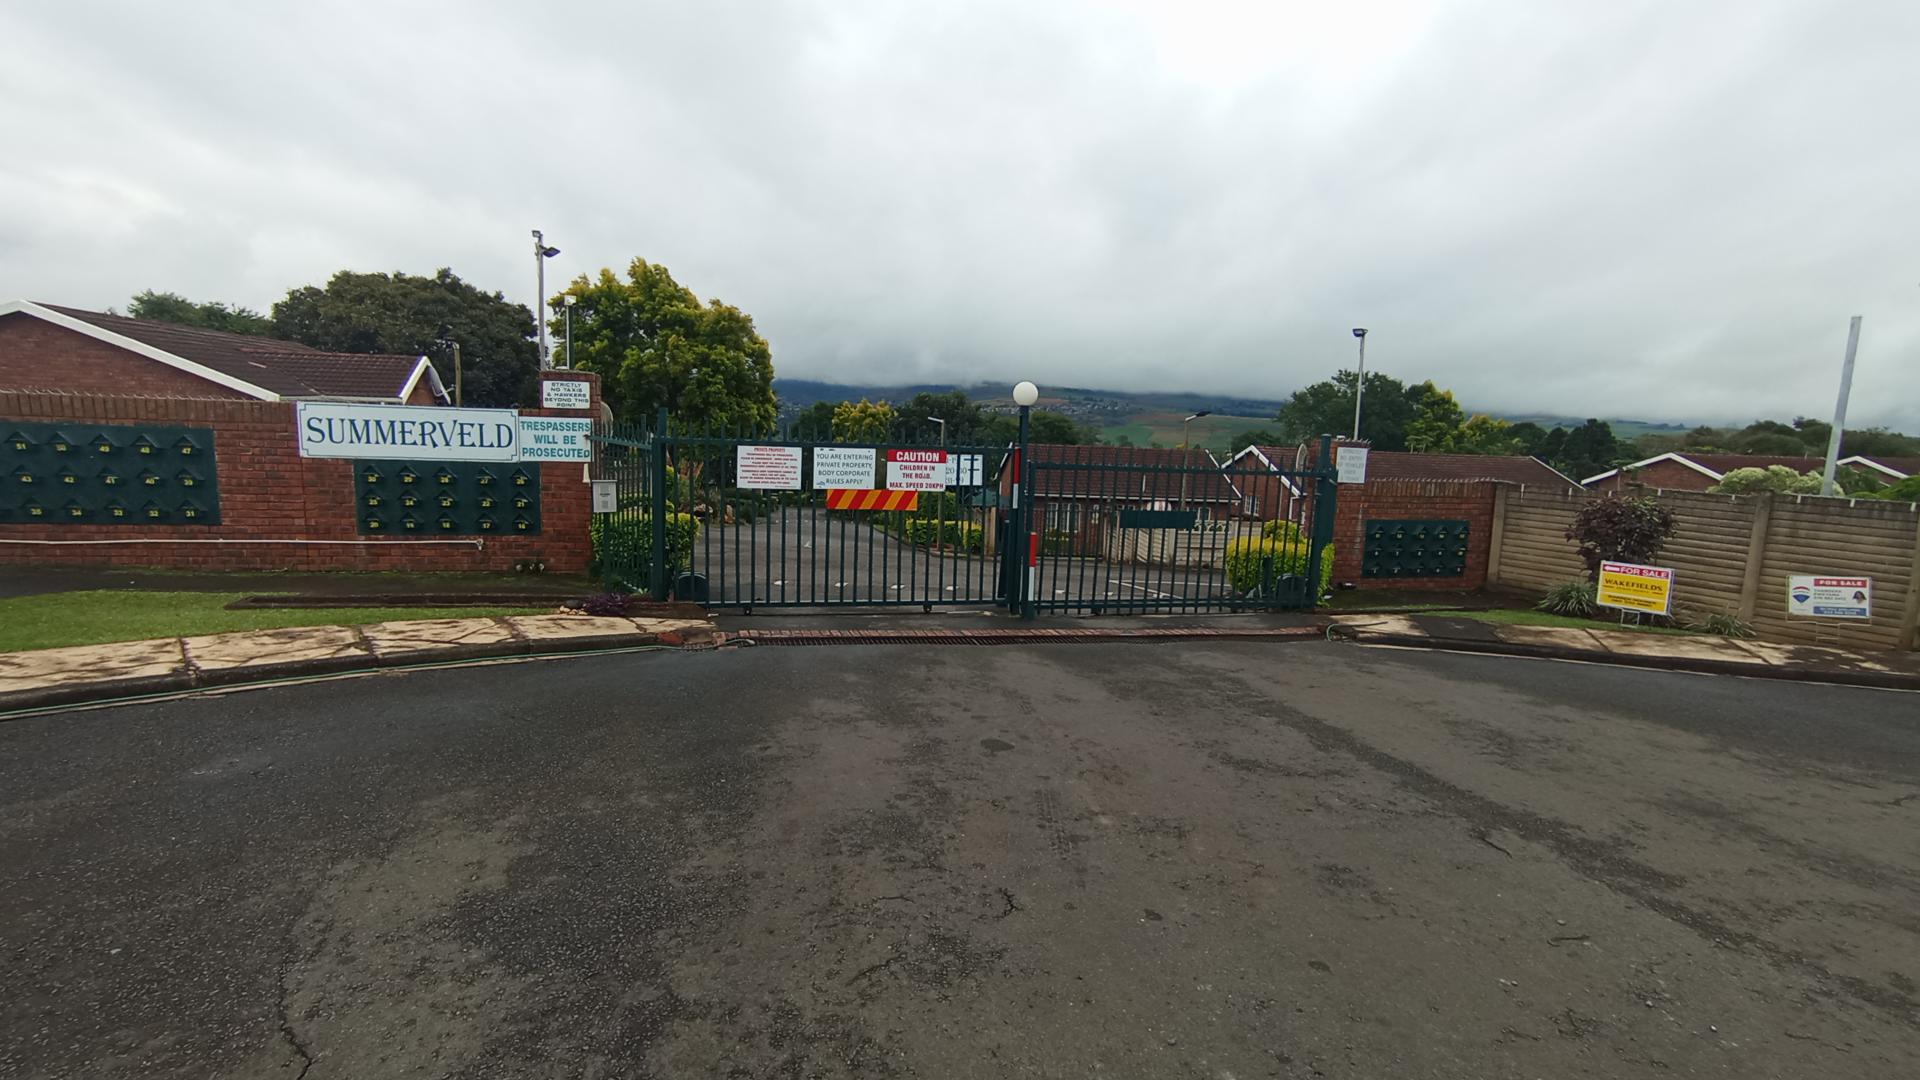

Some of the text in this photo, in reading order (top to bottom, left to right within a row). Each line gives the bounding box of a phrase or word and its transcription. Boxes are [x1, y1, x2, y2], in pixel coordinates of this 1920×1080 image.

[520, 421, 591, 432] TRESPASSERS
[306, 416, 513, 449] SUMMERVELD
[533, 435, 577, 445] WILL BE
[522, 447, 590, 458] PROSECUTED
[896, 451, 940, 462] CAUTION
[1620, 566, 1668, 578] FOR SALE
[1605, 578, 1663, 591] WAKEFIELDS
